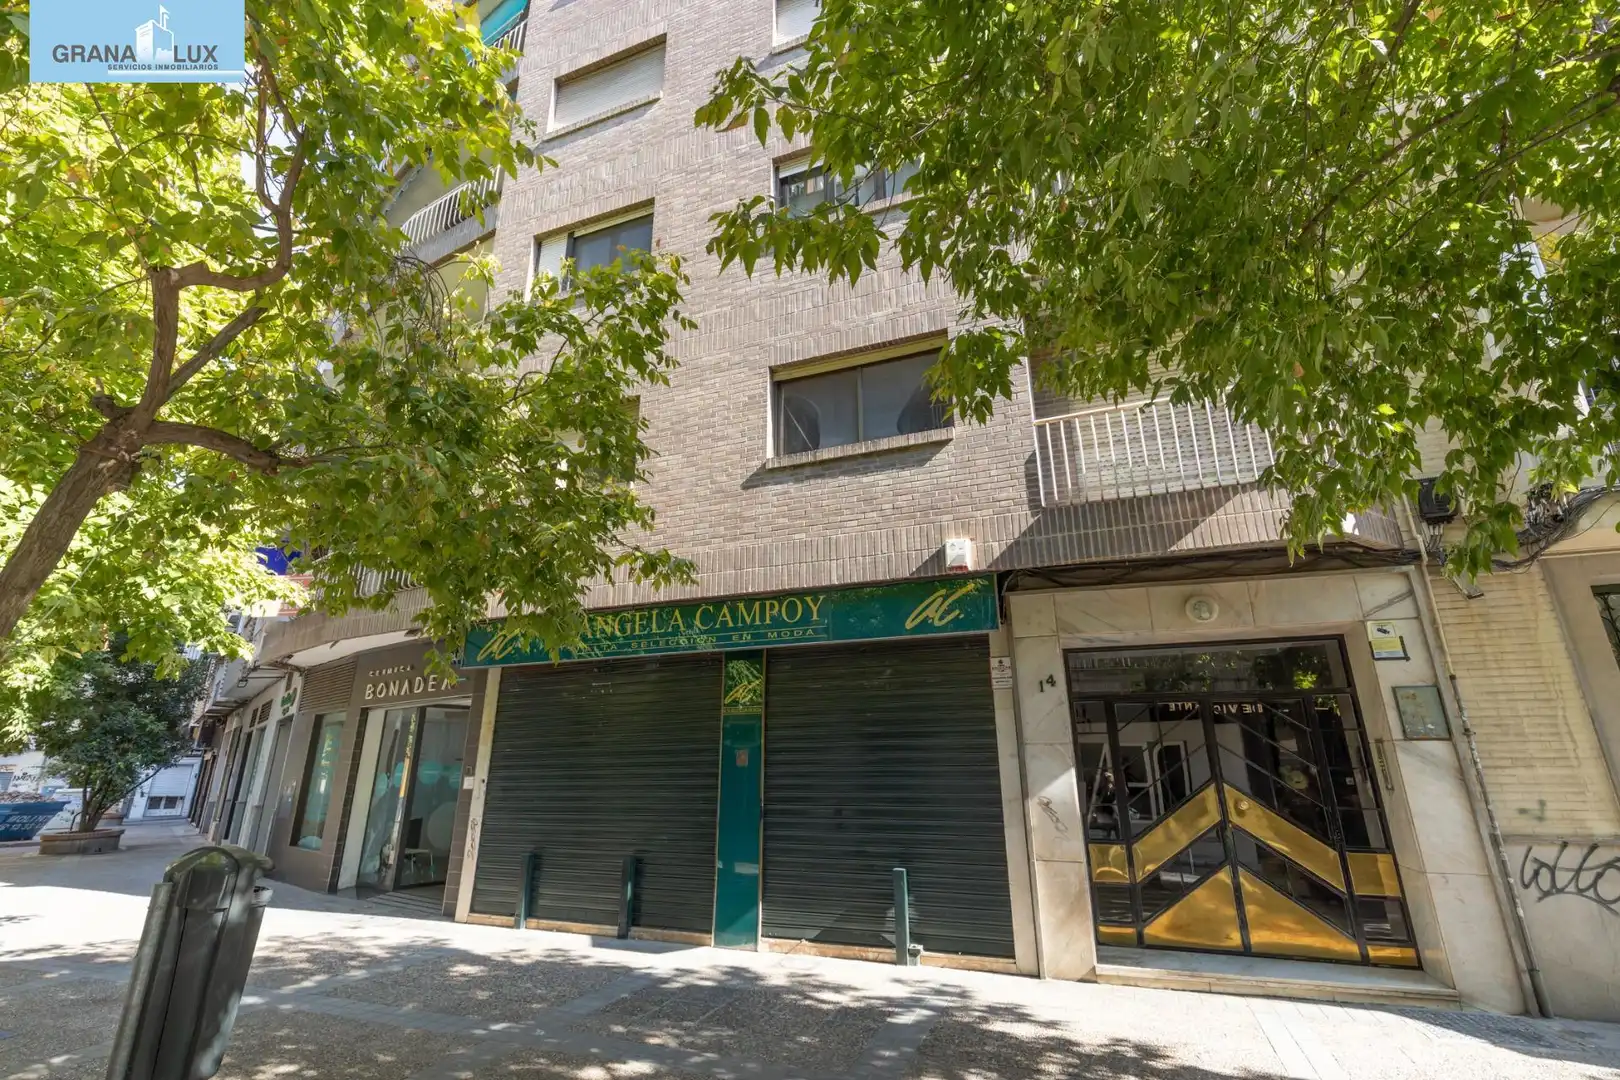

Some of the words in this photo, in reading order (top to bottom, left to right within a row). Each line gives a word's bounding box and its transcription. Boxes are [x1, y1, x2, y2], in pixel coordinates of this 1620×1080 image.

[694, 595, 826, 630] CAMPOY
[731, 633, 751, 641] EN
[767, 629, 815, 639] MODA
[365, 675, 452, 700] BONADEA
[1039, 674, 1057, 693] 14
